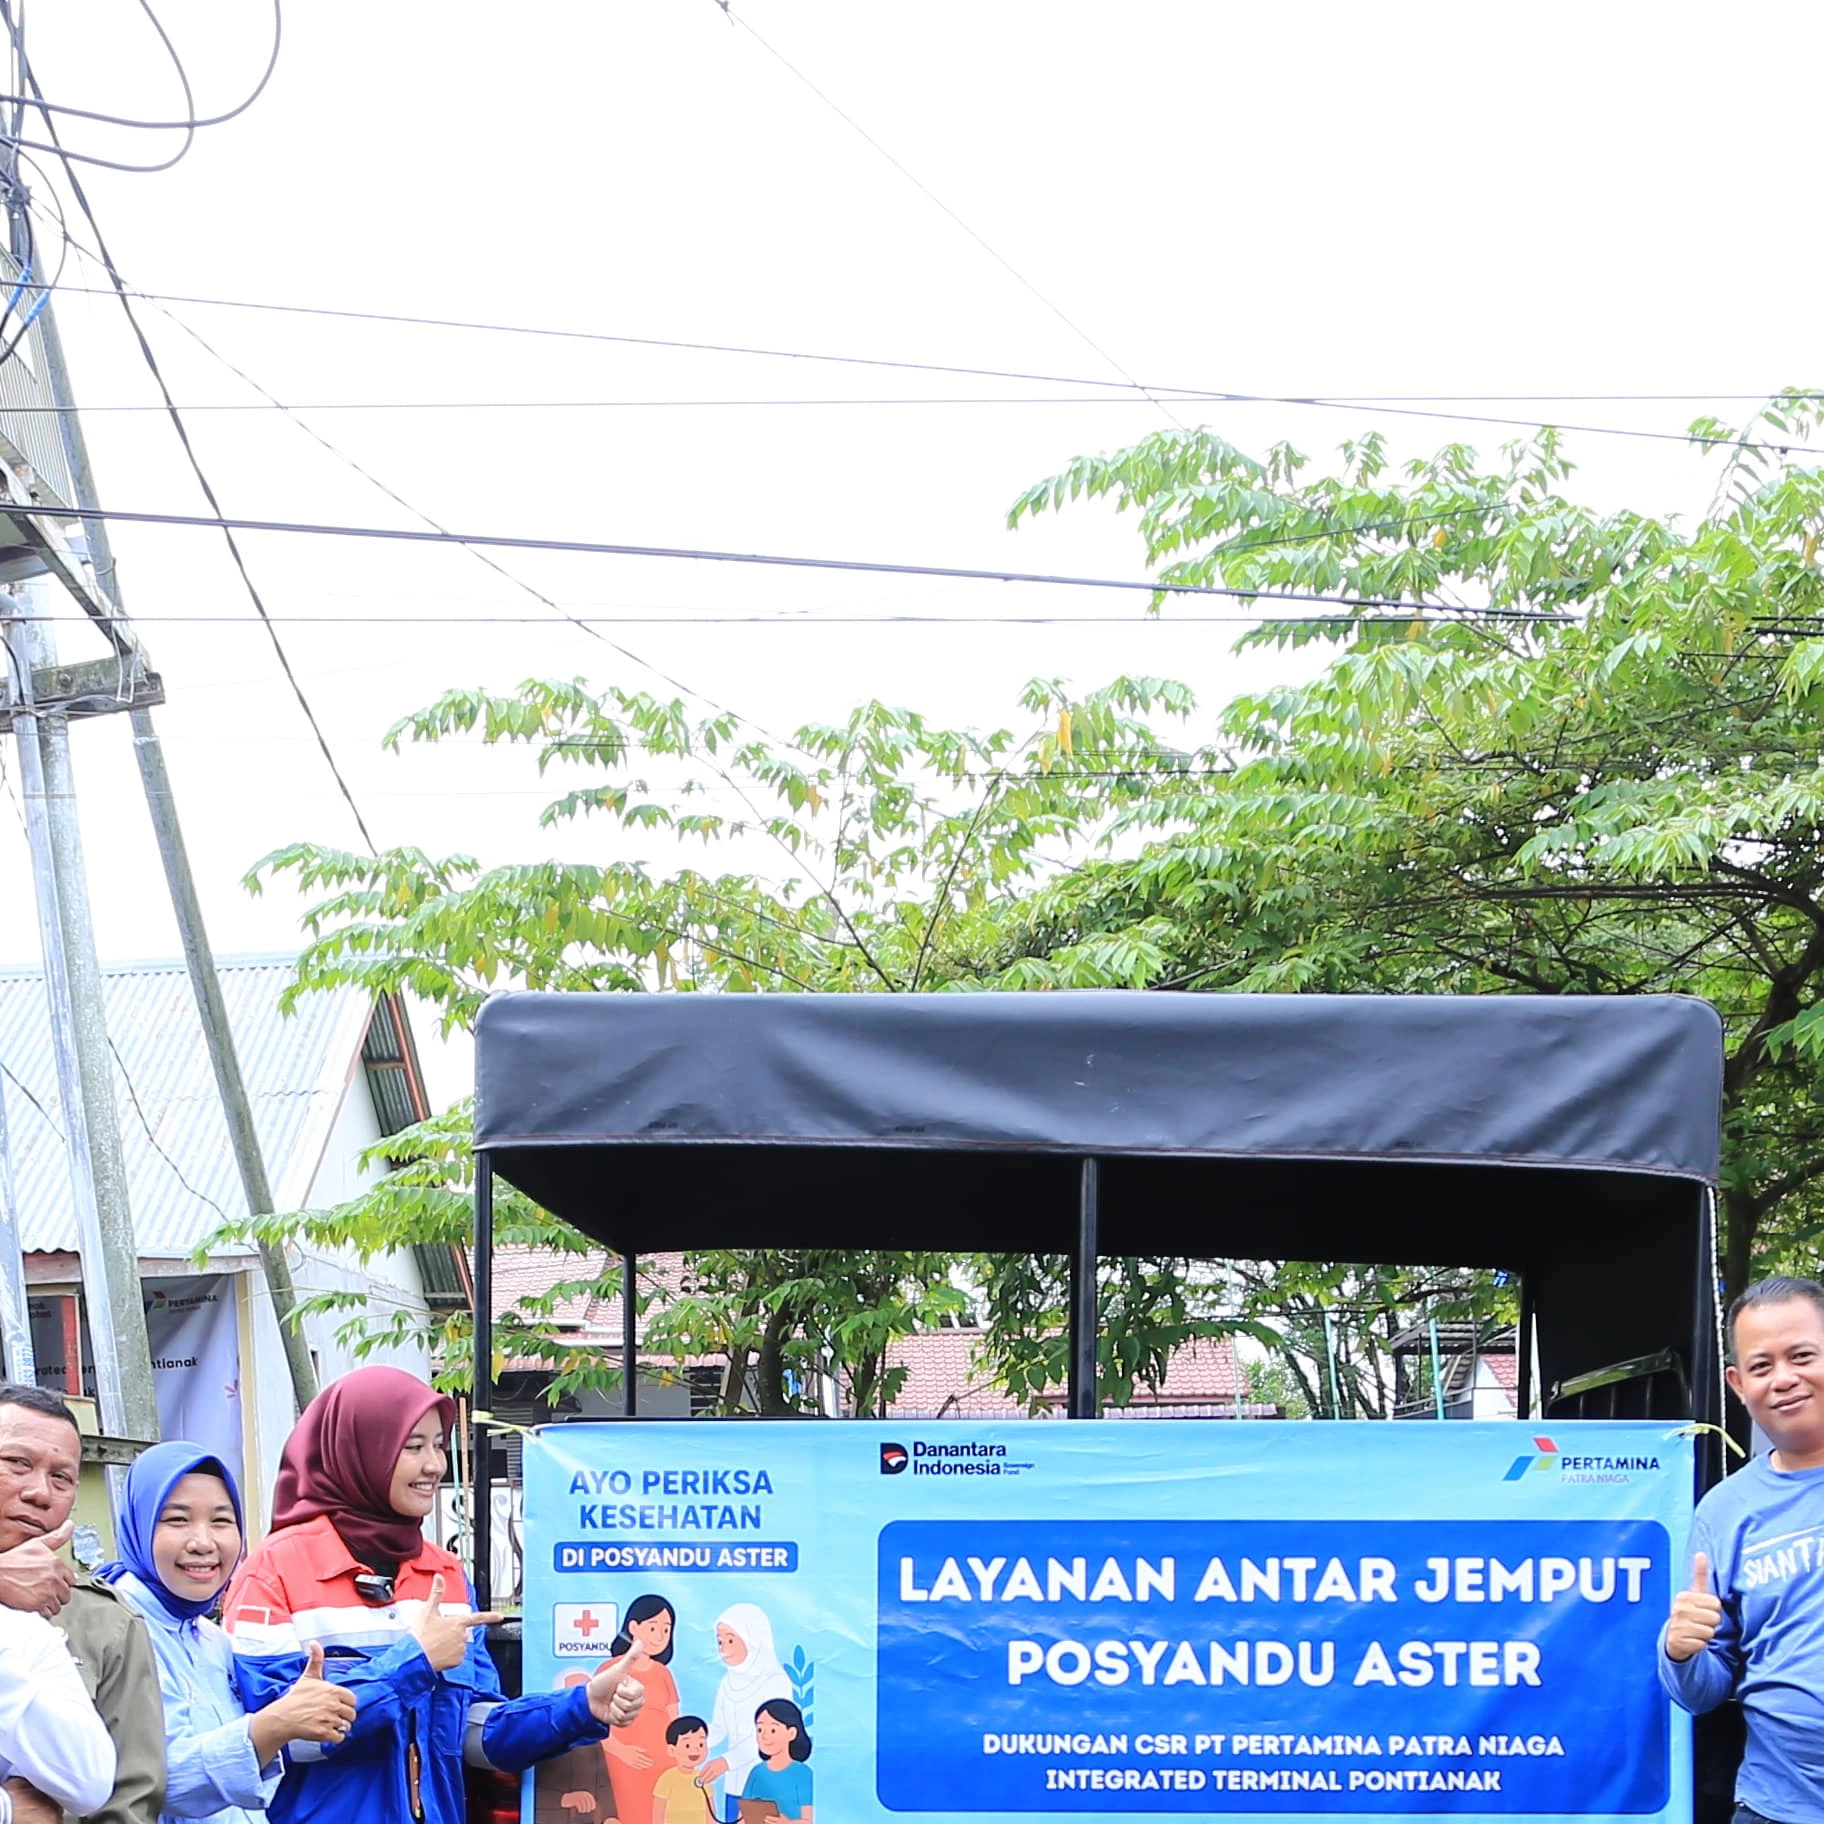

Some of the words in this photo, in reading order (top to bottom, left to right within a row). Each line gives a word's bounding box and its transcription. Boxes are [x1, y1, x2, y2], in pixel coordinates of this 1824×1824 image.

[913, 1441, 1006, 1457] Danantara
[913, 1460, 1001, 1475] Indonesia
[1561, 1457, 1660, 1470] PERTAMINA
[569, 1470, 632, 1495] AYO
[642, 1470, 773, 1495] PERIKSA
[1561, 1474, 1595, 1483] PATRA
[1597, 1474, 1629, 1483] NIAGA
[580, 1504, 761, 1529] KESEHATAN
[562, 1548, 584, 1567] DI
[591, 1547, 711, 1567] POSYANDU
[717, 1547, 788, 1567] ASTER
[900, 1556, 1175, 1602] LAYANAN
[1194, 1556, 1398, 1602] ANTAR
[1414, 1556, 1651, 1603] JEMPUT
[559, 1642, 612, 1652] POSYANDU
[1008, 1640, 1336, 1686] POSYANDU
[1353, 1640, 1543, 1687] ASTER
[983, 1734, 1127, 1754] DUKUNGAN
[1135, 1734, 1188, 1754] CSR
[1195, 1735, 1225, 1754] PT
[1232, 1735, 1382, 1756] PERTAMINA
[1388, 1736, 1473, 1756] PATRA
[1479, 1736, 1565, 1756] NIAGA
[1046, 1769, 1206, 1790] INTEGRATED
[1212, 1770, 1342, 1791] TERMINAL
[1349, 1771, 1501, 1791] PONTIANAK
